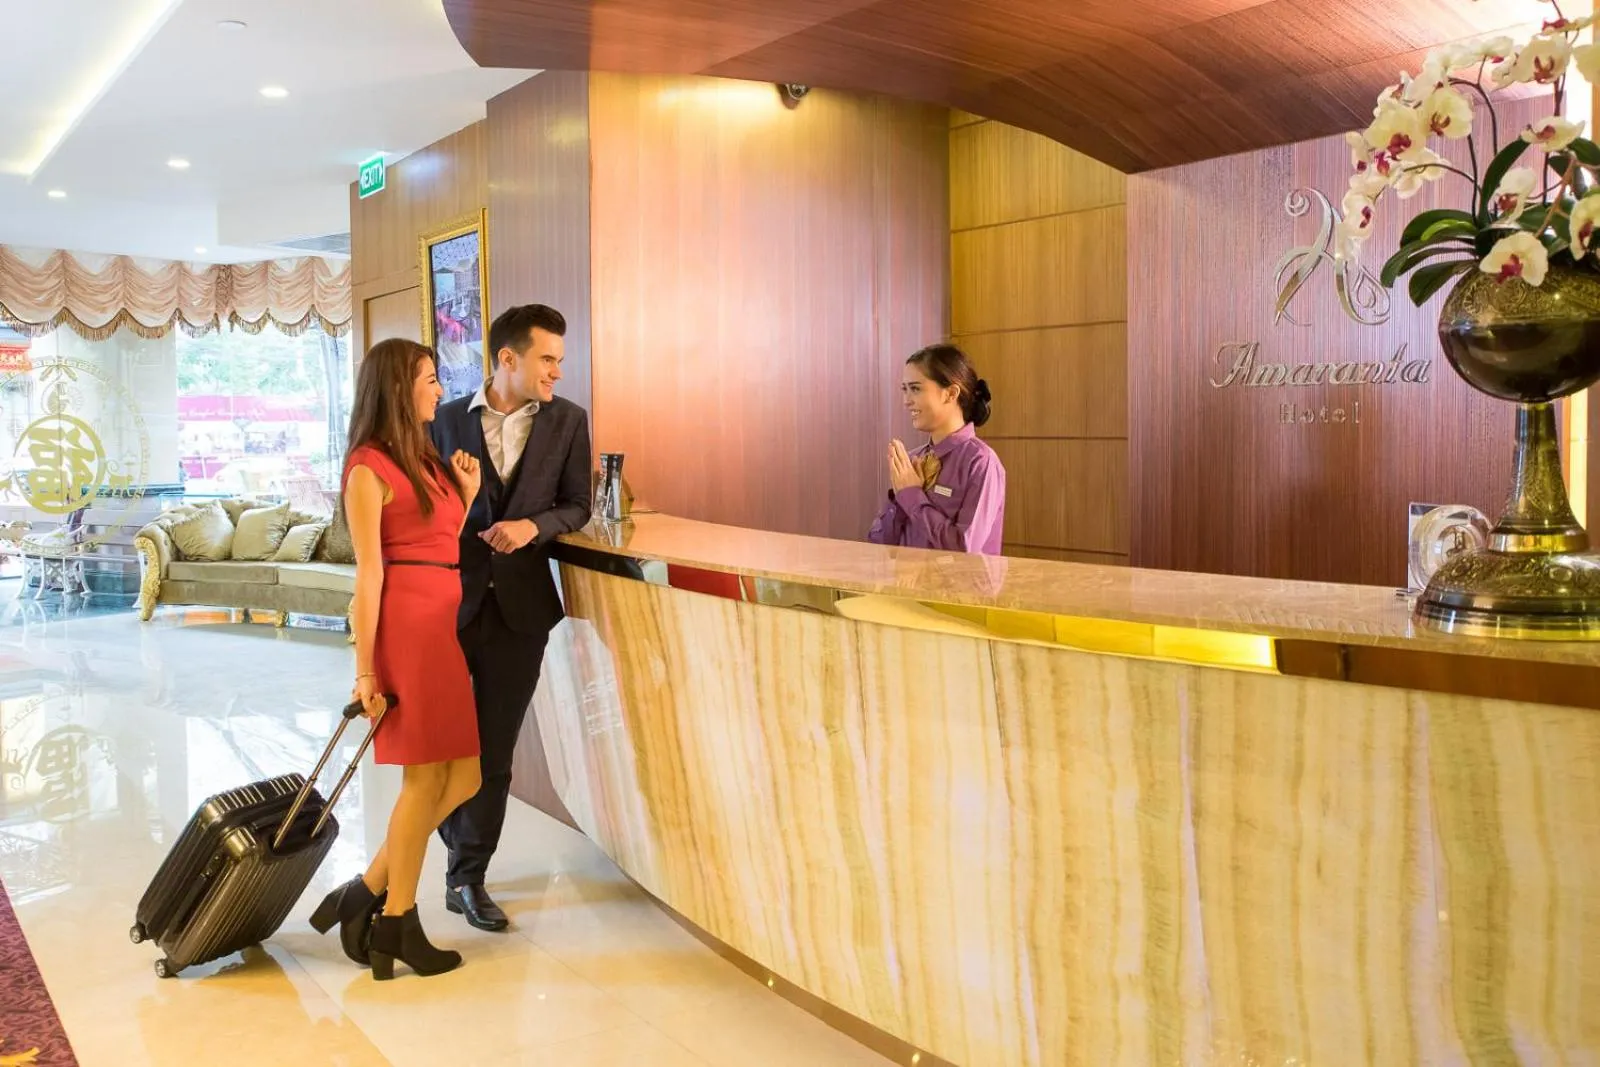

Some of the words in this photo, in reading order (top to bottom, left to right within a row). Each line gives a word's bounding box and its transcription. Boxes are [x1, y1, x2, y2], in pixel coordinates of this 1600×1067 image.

[363, 164, 381, 189] EXIT
[1209, 341, 1432, 388] Amaranta
[1279, 402, 1361, 424] Hotel
